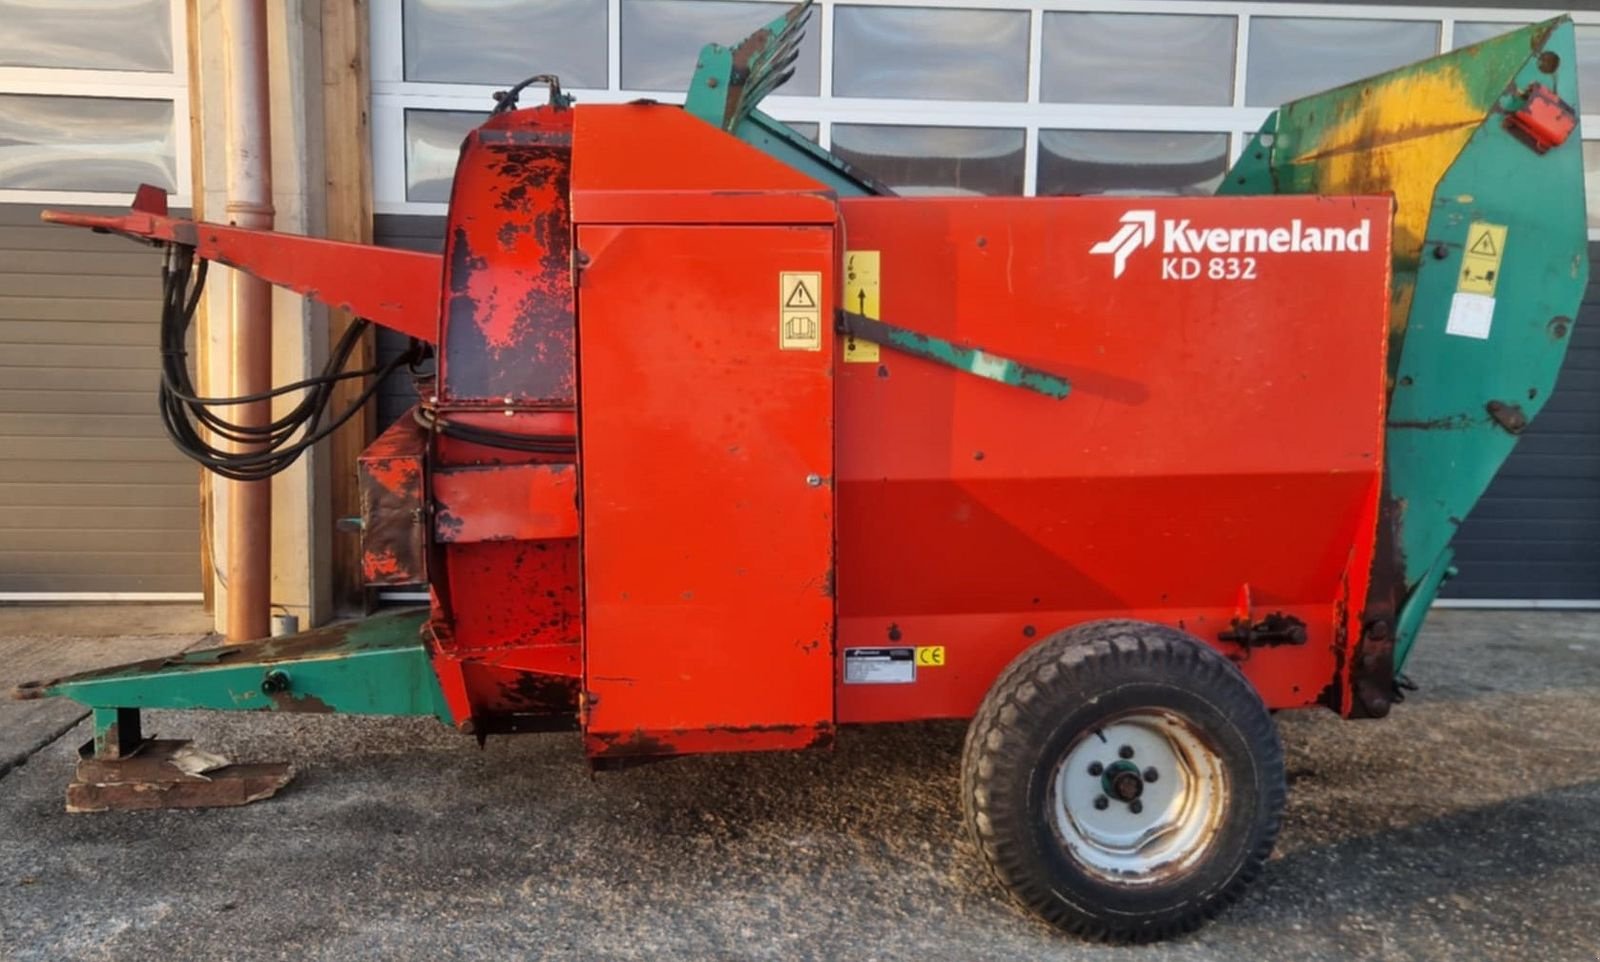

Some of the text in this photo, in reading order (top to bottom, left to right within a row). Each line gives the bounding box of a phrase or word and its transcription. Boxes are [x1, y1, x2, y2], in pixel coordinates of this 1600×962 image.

[1163, 219, 1370, 253] Kverneland
[1162, 258, 1256, 280] KD 832
